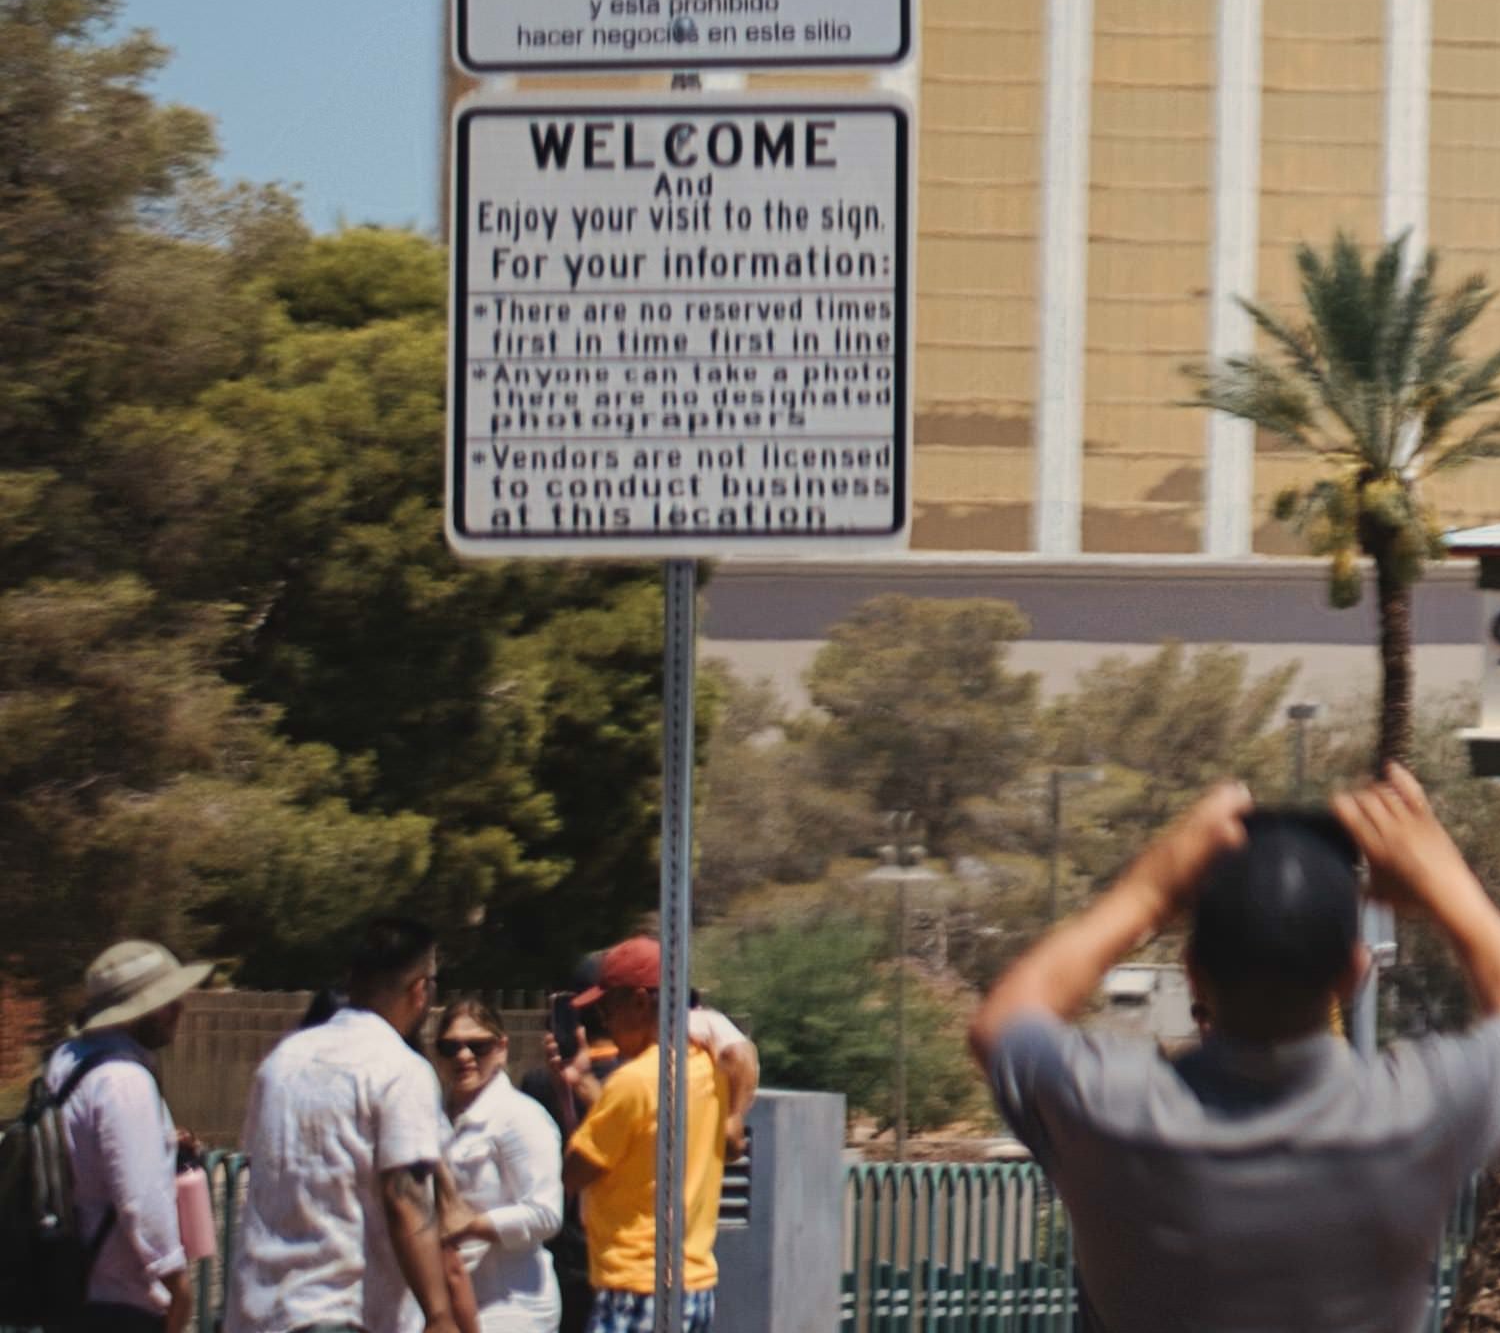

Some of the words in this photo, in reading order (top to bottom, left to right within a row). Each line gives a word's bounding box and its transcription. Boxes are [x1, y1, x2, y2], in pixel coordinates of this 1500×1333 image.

[590, 0, 601, 20] y
[518, 25, 584, 49] hacer
[708, 24, 737, 44] en
[745, 23, 795, 43] este
[804, 20, 852, 42] sitio
[530, 121, 838, 170] WELCOME
[654, 172, 713, 197] And
[478, 200, 558, 240] Enjoy
[572, 204, 638, 239] your
[649, 200, 711, 232] visit
[725, 200, 752, 232] to
[765, 200, 809, 232] the
[821, 200, 885, 239] sign.
[493, 248, 548, 281] For
[565, 252, 647, 287] your
[664, 246, 891, 279] information:
[584, 302, 627, 322] are
[640, 302, 672, 321] no
[685, 298, 803, 322] reserved
[815, 297, 891, 321] times
[493, 329, 558, 354] first
[575, 329, 601, 354] in
[618, 329, 687, 353] time
[710, 329, 776, 353] first
[793, 329, 818, 353] in
[834, 329, 891, 351] line
[625, 367, 677, 385] can
[693, 362, 757, 385] take
[773, 367, 788, 383] a
[803, 362, 891, 388] photo
[493, 389, 579, 411] there
[596, 391, 644, 410] are
[662, 391, 698, 409] no
[713, 386, 891, 412] designated
[491, 409, 806, 437] photographers
[633, 448, 682, 470] are
[698, 443, 747, 470] not
[763, 443, 891, 470] licensed
[492, 473, 528, 497] to
[547, 473, 700, 497] conduct
[723, 472, 891, 497] business
[491, 505, 529, 529] at
[552, 504, 630, 528] this
